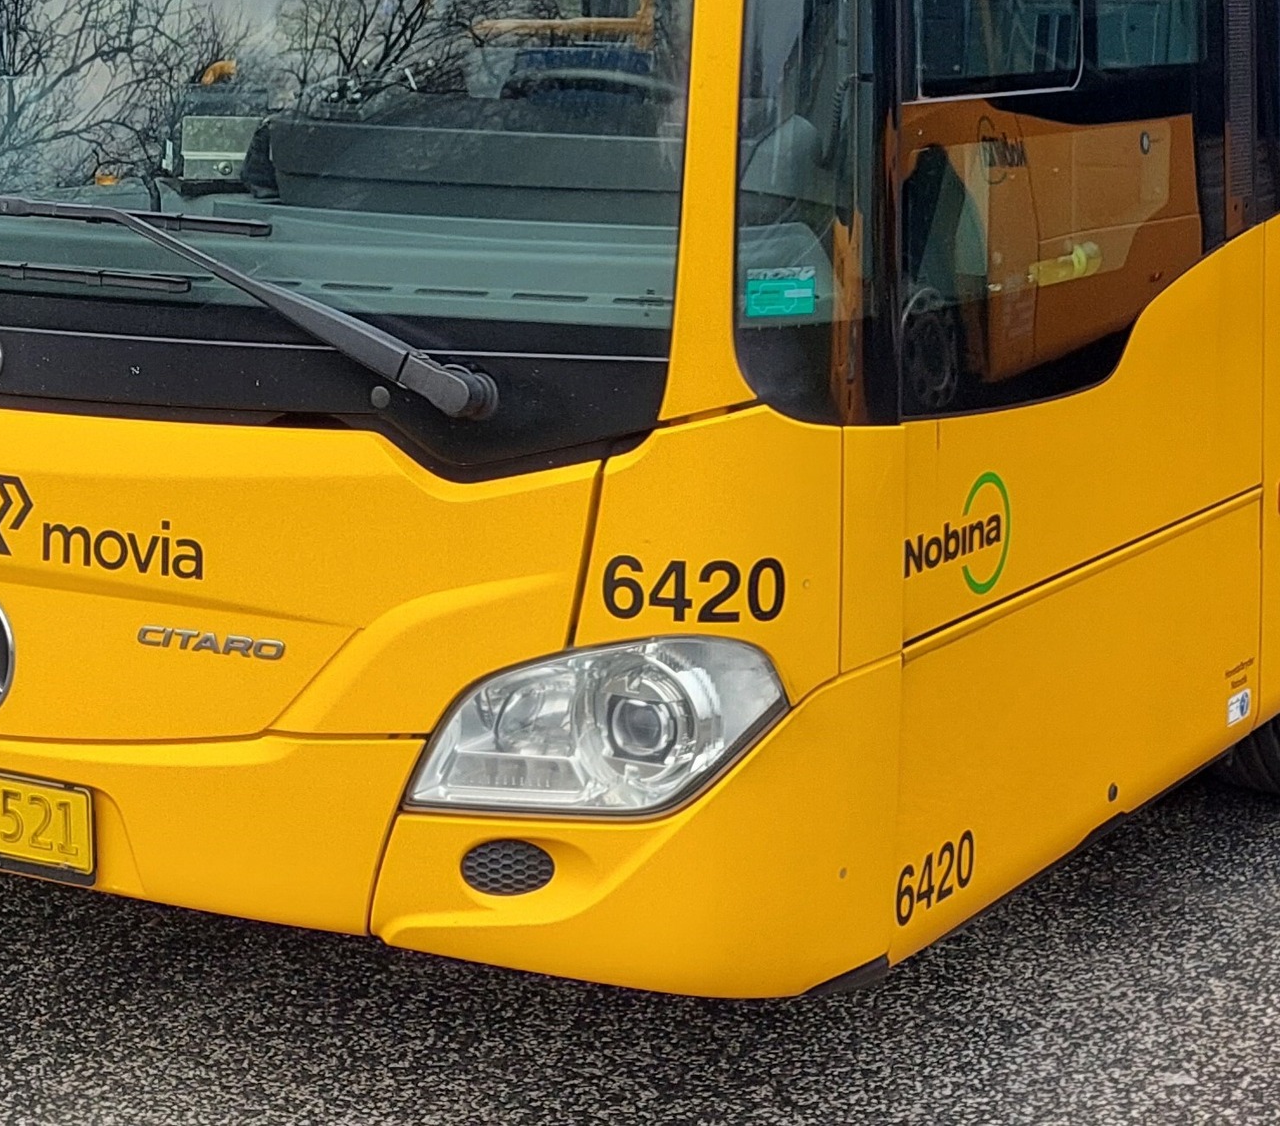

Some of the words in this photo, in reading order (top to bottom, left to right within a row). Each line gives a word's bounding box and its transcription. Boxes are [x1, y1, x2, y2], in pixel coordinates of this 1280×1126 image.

[42, 520, 204, 580] movia
[903, 513, 1002, 580] Nobina
[602, 554, 786, 624] 6420
[136, 624, 286, 661] CITARO
[0, 788, 79, 856] 521
[895, 828, 975, 927] 6420
